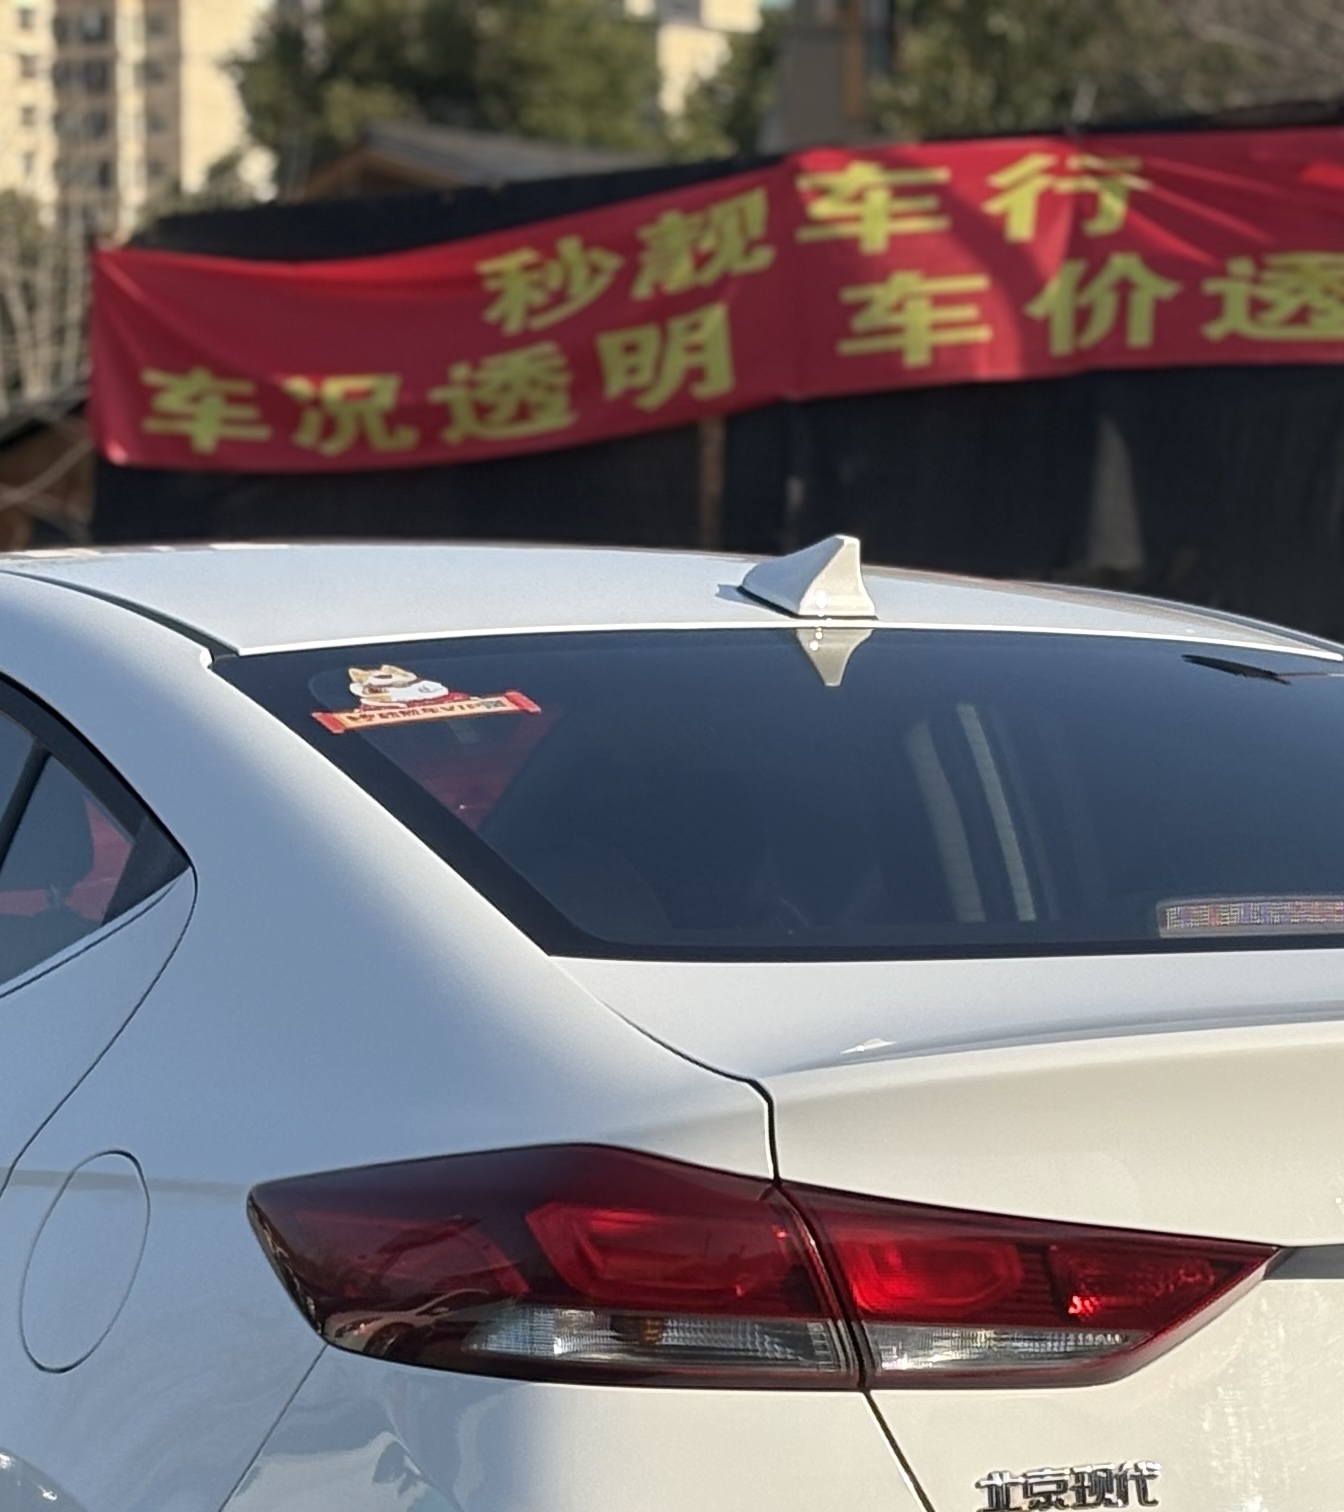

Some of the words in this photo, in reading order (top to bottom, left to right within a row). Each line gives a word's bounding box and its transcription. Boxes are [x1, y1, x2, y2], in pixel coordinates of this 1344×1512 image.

[474, 152, 1146, 336] 秒靓车行
[140, 303, 736, 455] 车况透明
